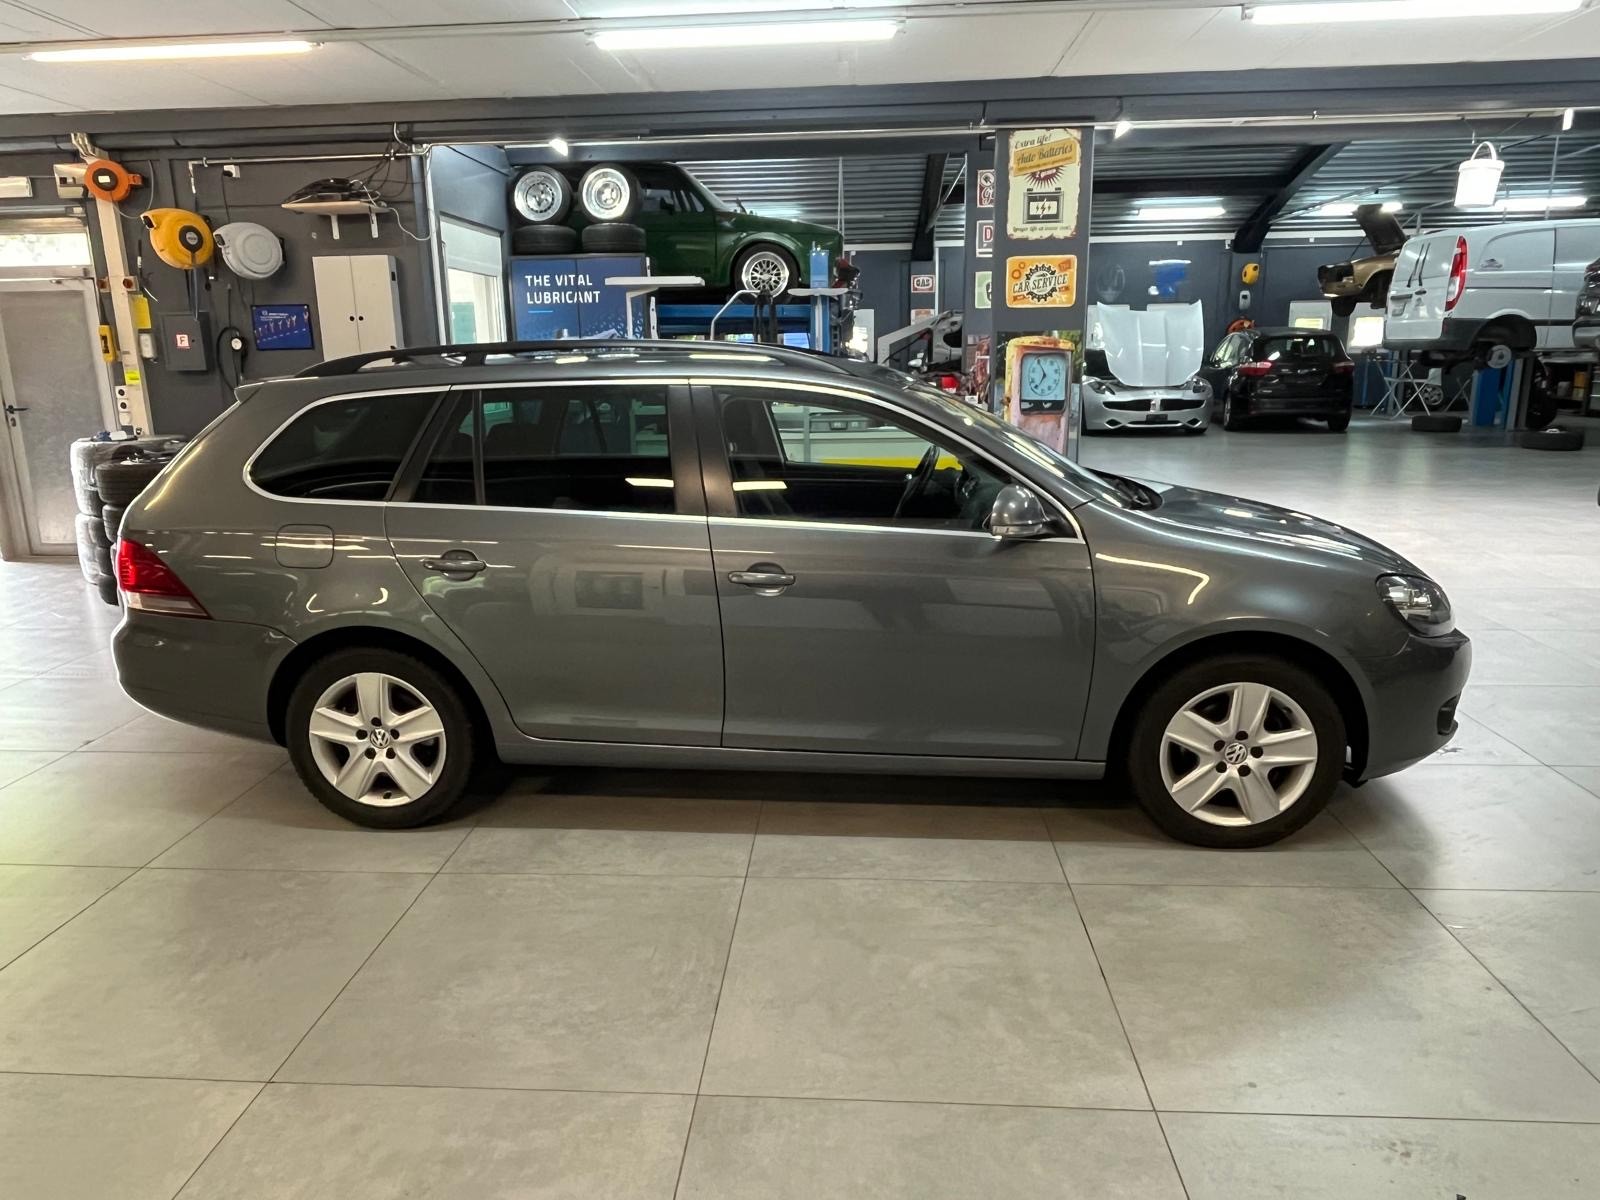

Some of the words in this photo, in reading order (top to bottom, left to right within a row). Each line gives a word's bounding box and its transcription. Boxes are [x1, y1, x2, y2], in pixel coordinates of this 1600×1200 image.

[1015, 138, 1035, 149] Extra
[1039, 143, 1073, 160] Batteries
[525, 275, 551, 287] THE
[555, 274, 593, 286] VITAL
[915, 278, 930, 287] GAS
[1012, 280, 1030, 293] CAR
[1032, 273, 1068, 290] SERVICE
[526, 290, 600, 304] LUBRICANT
